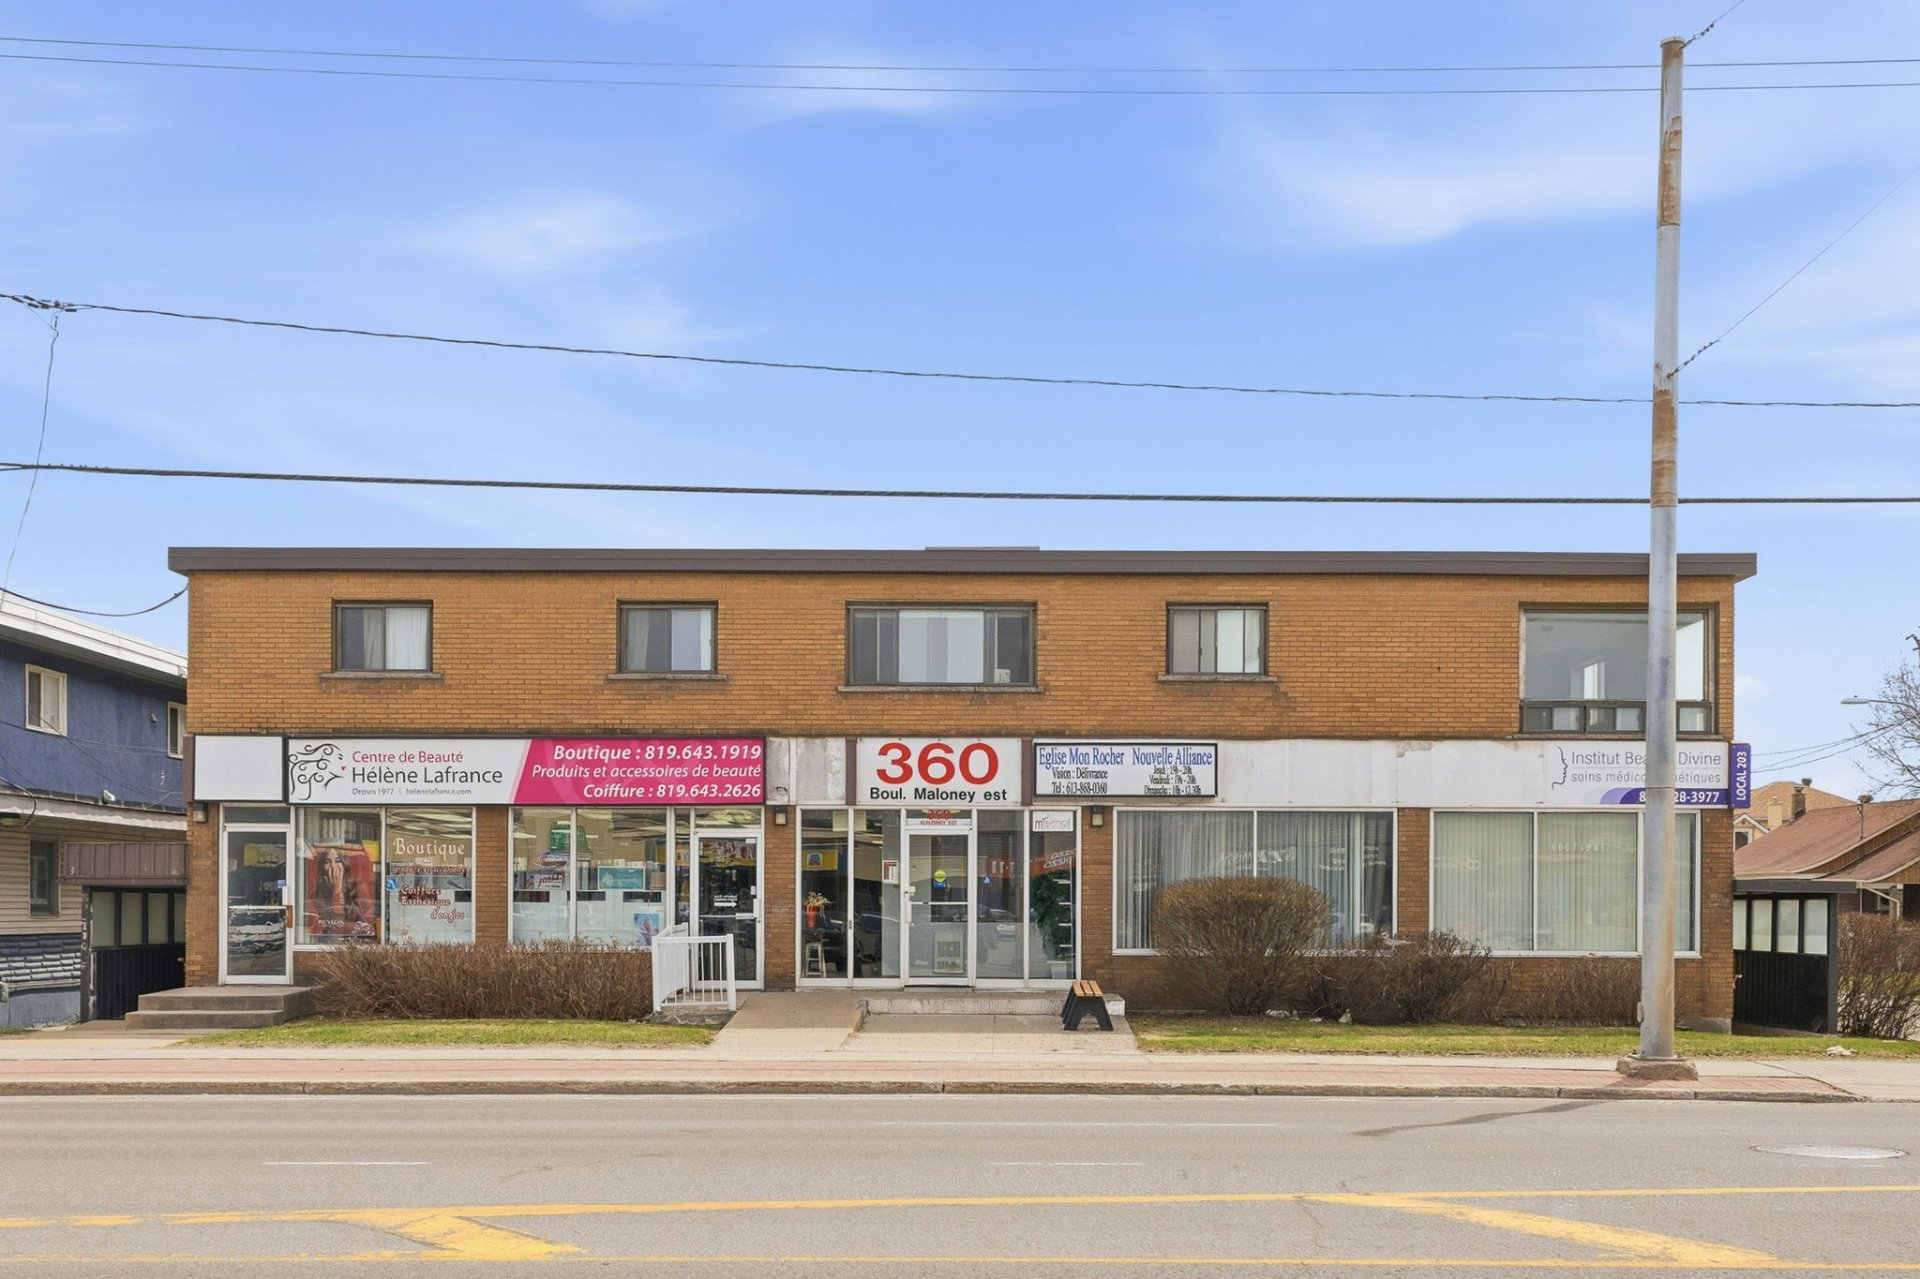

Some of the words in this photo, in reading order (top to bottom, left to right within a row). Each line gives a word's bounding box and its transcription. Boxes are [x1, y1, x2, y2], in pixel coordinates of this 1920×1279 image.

[352, 751, 395, 763] Centre
[399, 751, 415, 763] de
[418, 751, 463, 763] Beauté
[554, 745, 631, 763] Boutique
[645, 745, 761, 759] 819.643.1919
[1039, 748, 1066, 769] Eglise
[1069, 748, 1091, 765] Mon
[1093, 748, 1125, 765] Rocher
[1132, 748, 1173, 765] Nouvelle
[1175, 748, 1212, 765] Alliance
[1571, 751, 1620, 765] Institut
[1625, 752, 1647, 765] Bea
[1678, 751, 1721, 765] Divine
[1737, 751, 1747, 768] 203
[532, 765, 590, 778] Produits
[593, 767, 607, 778] et
[610, 765, 688, 778] accessoires
[692, 764, 709, 777] de
[713, 764, 761, 777] beauté
[876, 742, 998, 785] 360
[352, 766, 418, 783] Hélène
[424, 766, 503, 783] Lafrance
[1052, 766, 1071, 779] Vision
[1571, 770, 1602, 783] soins
[352, 788, 376, 796] Depuis
[583, 784, 645, 798] Coiffure
[656, 784, 761, 798] 819.643.2626
[1051, 782, 1062, 794] Tel
[1736, 770, 1747, 801] LOCAL
[870, 787, 906, 799] Boul.
[914, 787, 976, 803] Maloney
[983, 789, 1007, 800] est
[393, 838, 465, 861] Boutique
